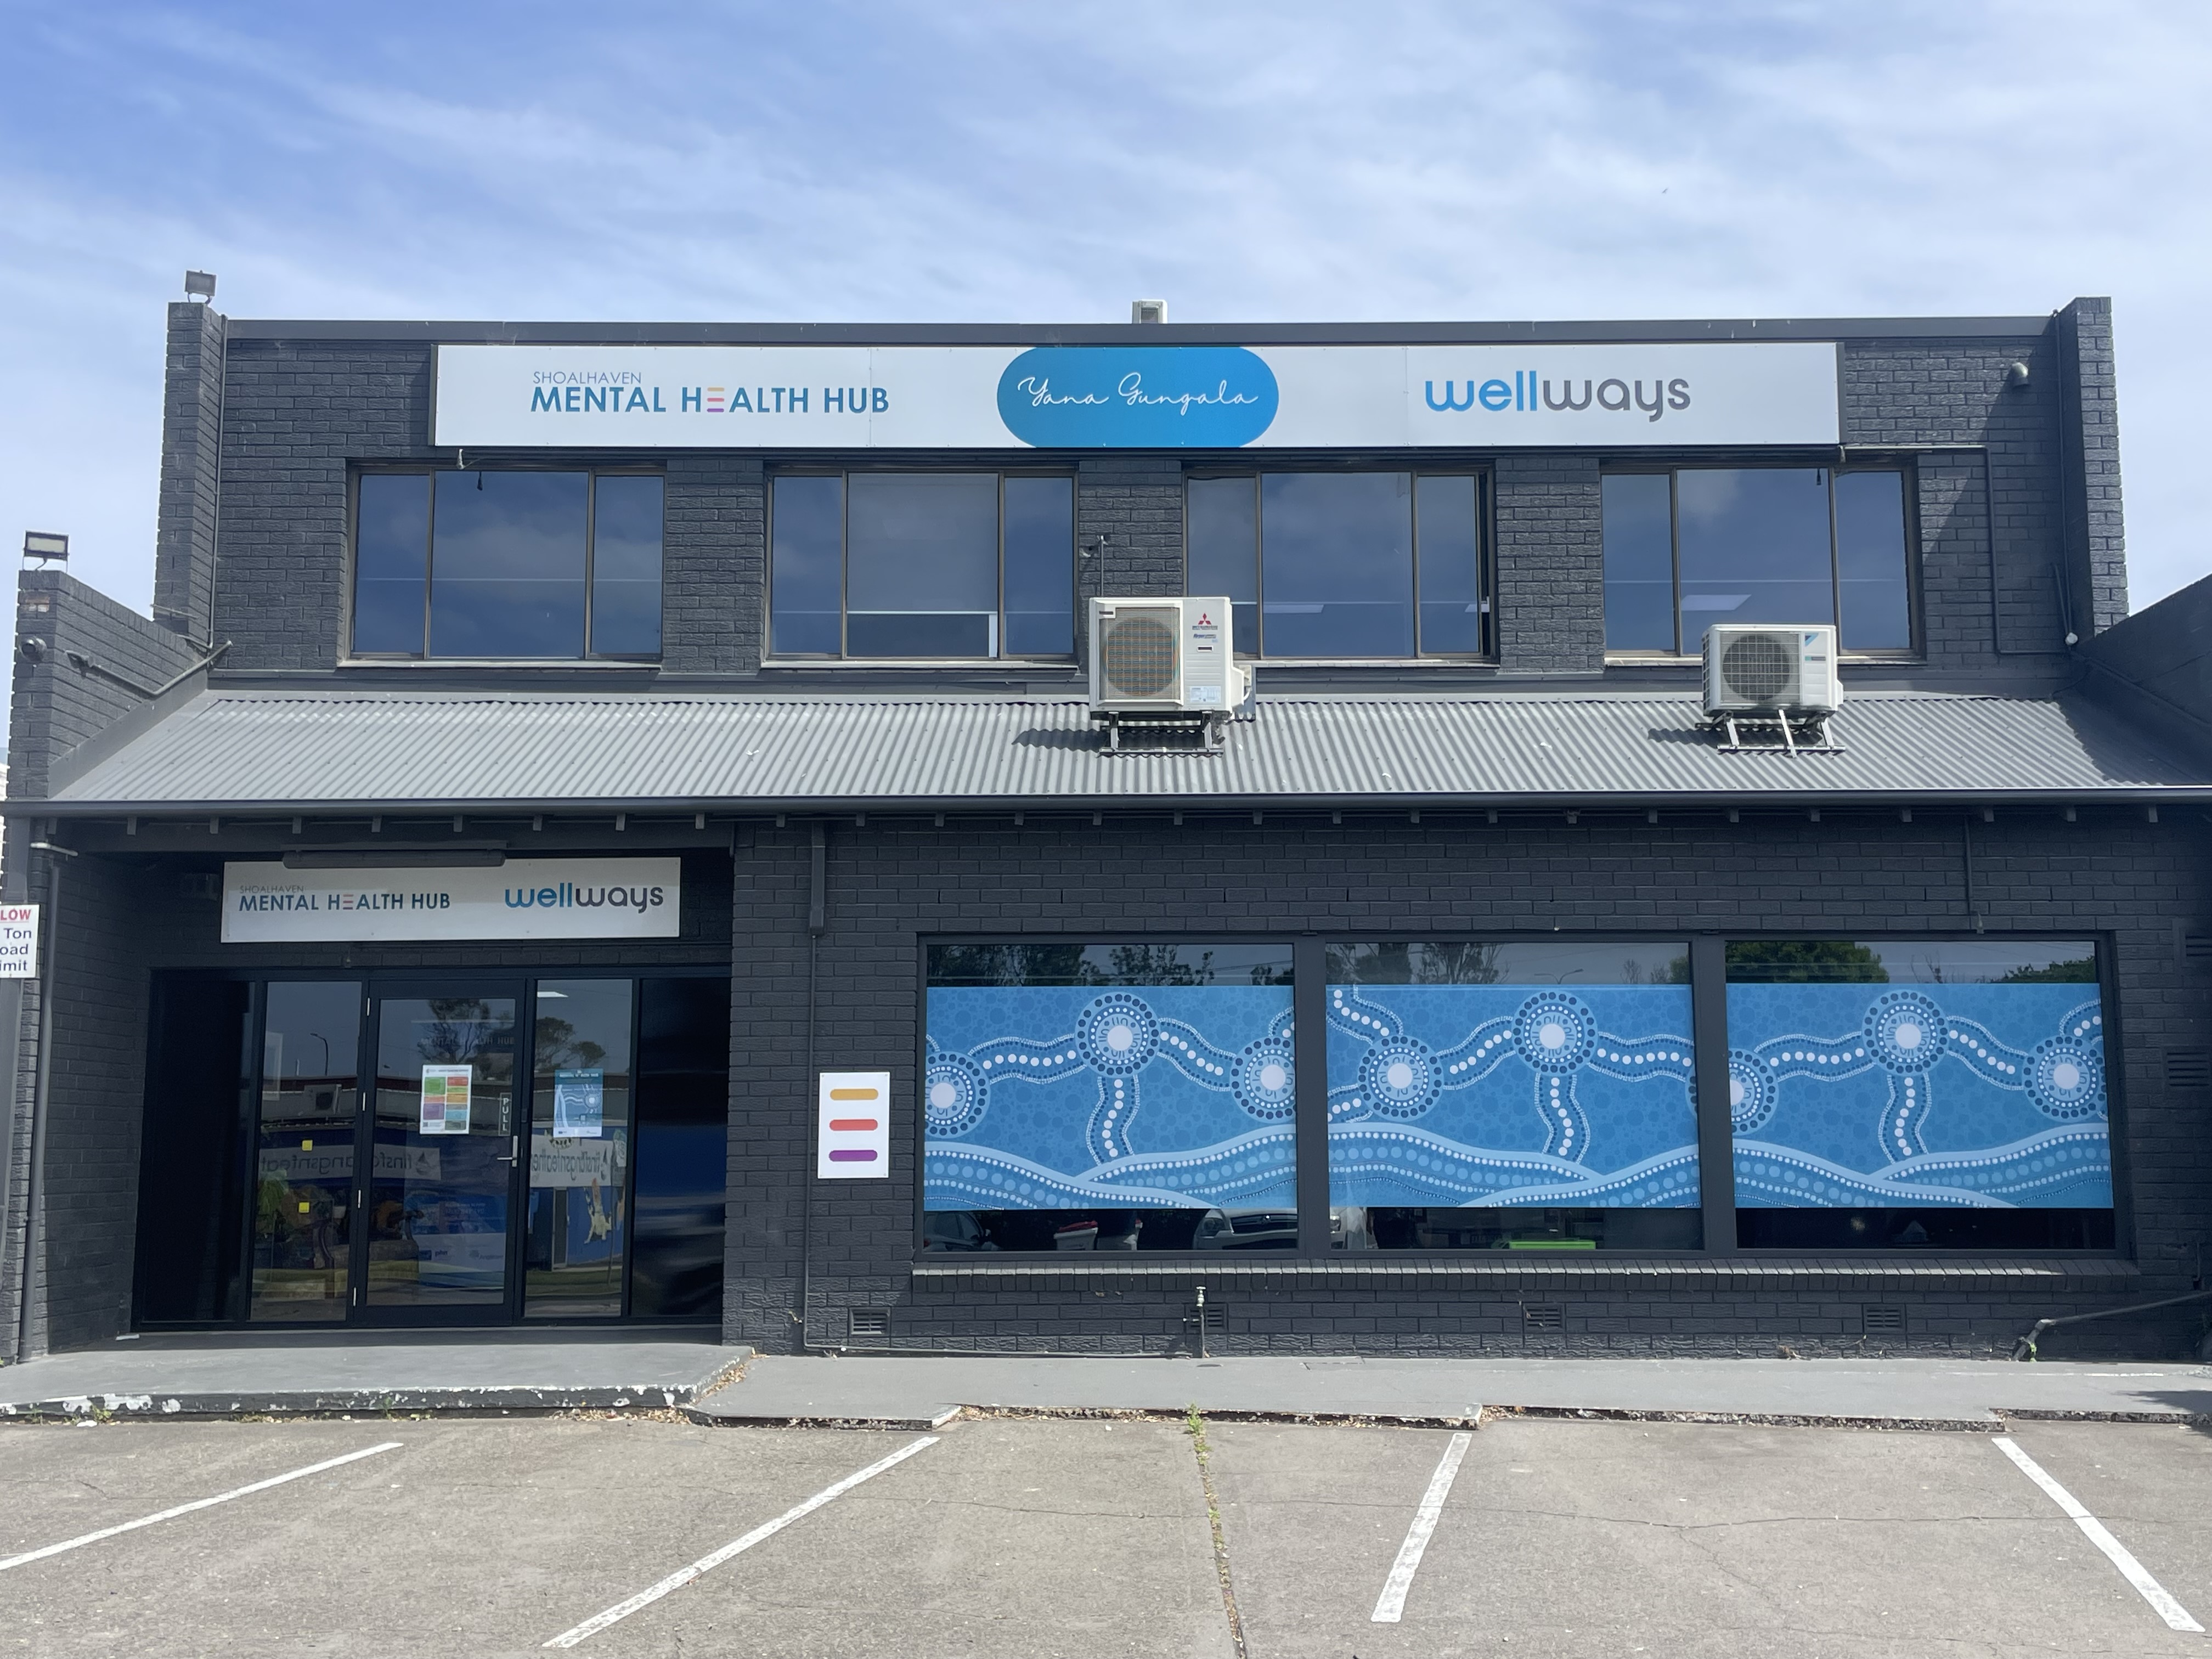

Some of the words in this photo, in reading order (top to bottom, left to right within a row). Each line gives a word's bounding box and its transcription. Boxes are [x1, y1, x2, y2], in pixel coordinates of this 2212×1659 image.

[533, 371, 641, 384] SHOALHAVEN
[531, 387, 666, 413] MENTAL
[681, 387, 809, 413] HEALTH
[824, 387, 889, 413] HUB
[1018, 376, 1109, 407] Yana
[1118, 372, 1259, 416] Gungala
[1425, 370, 1690, 422] wellways
[240, 885, 304, 894] SHOALHAVEN
[239, 894, 319, 911] MENTAL
[328, 893, 403, 911] HEALTH
[411, 893, 450, 910] HUB
[505, 882, 663, 913] wellways
[3, 927, 32, 939] Ton
[0, 943, 29, 955] oad
[0, 959, 27, 972] imit
